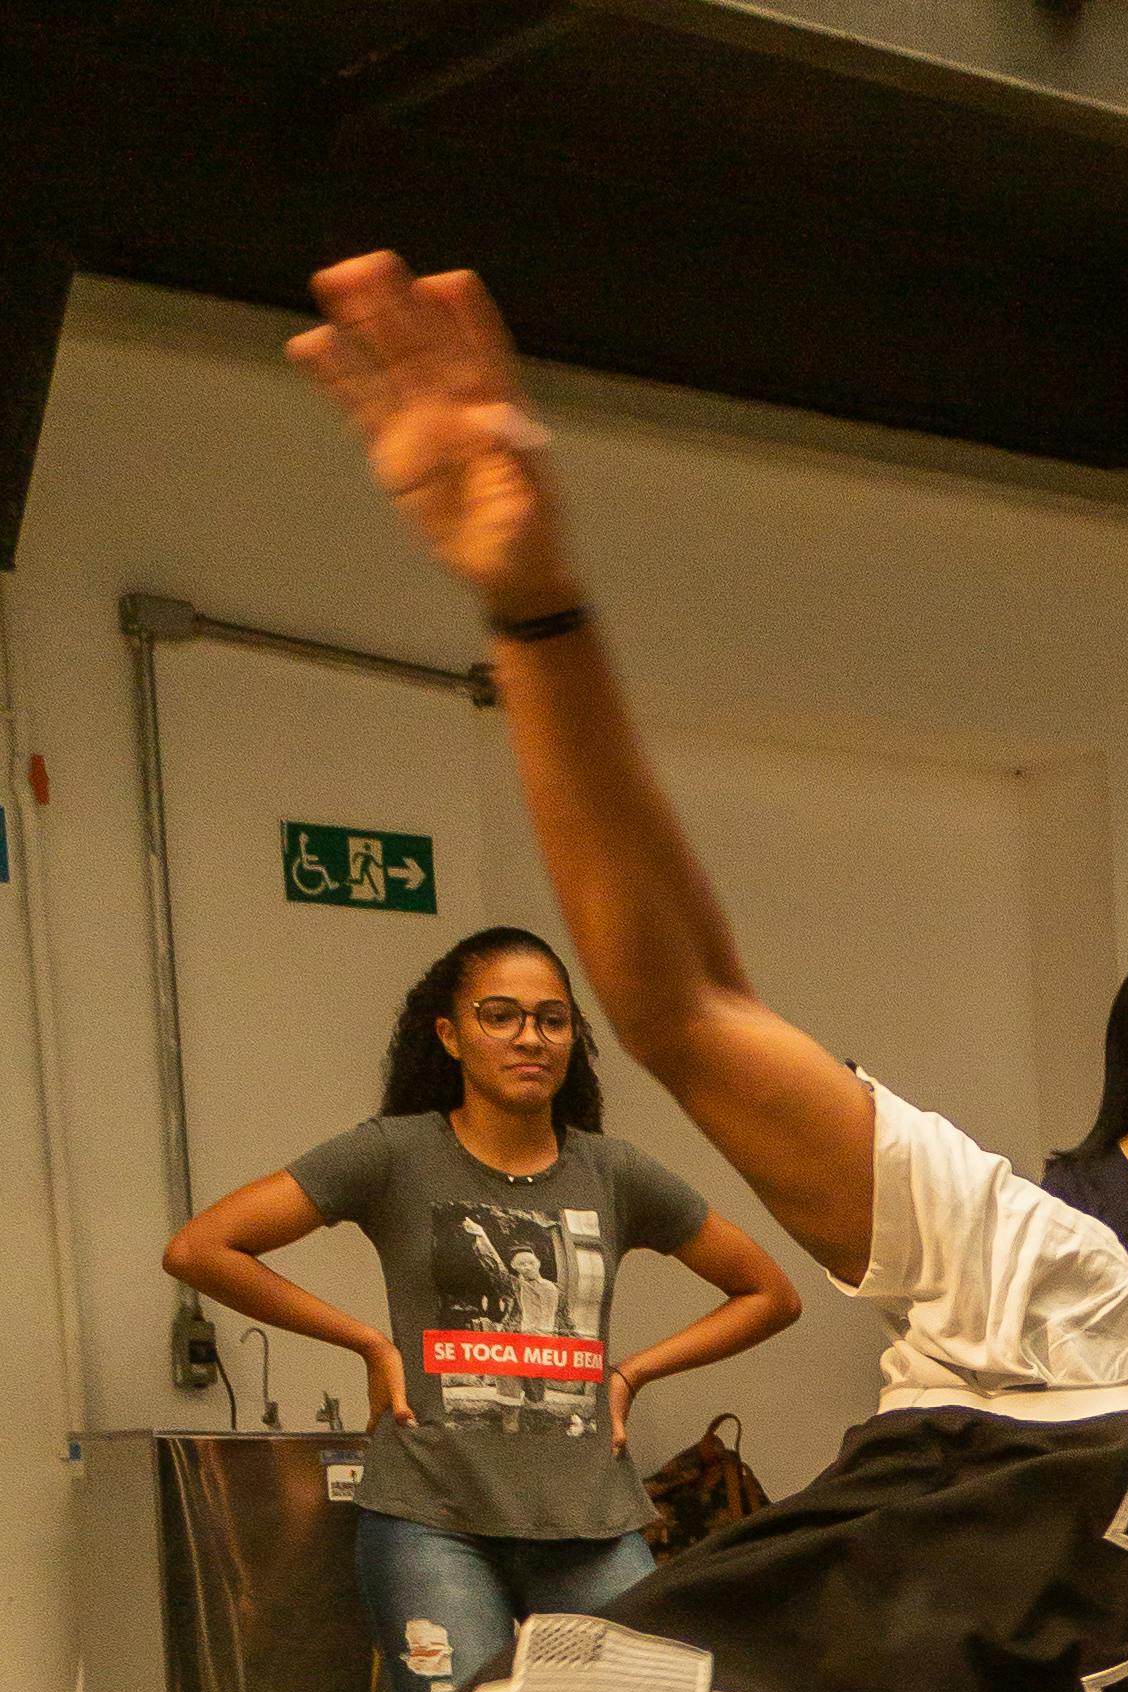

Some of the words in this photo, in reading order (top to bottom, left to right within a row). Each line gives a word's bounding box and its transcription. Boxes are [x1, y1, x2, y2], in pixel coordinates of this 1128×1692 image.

[434, 1342, 456, 1360] SE
[460, 1343, 518, 1363] TOCA
[523, 1347, 568, 1367] MEU
